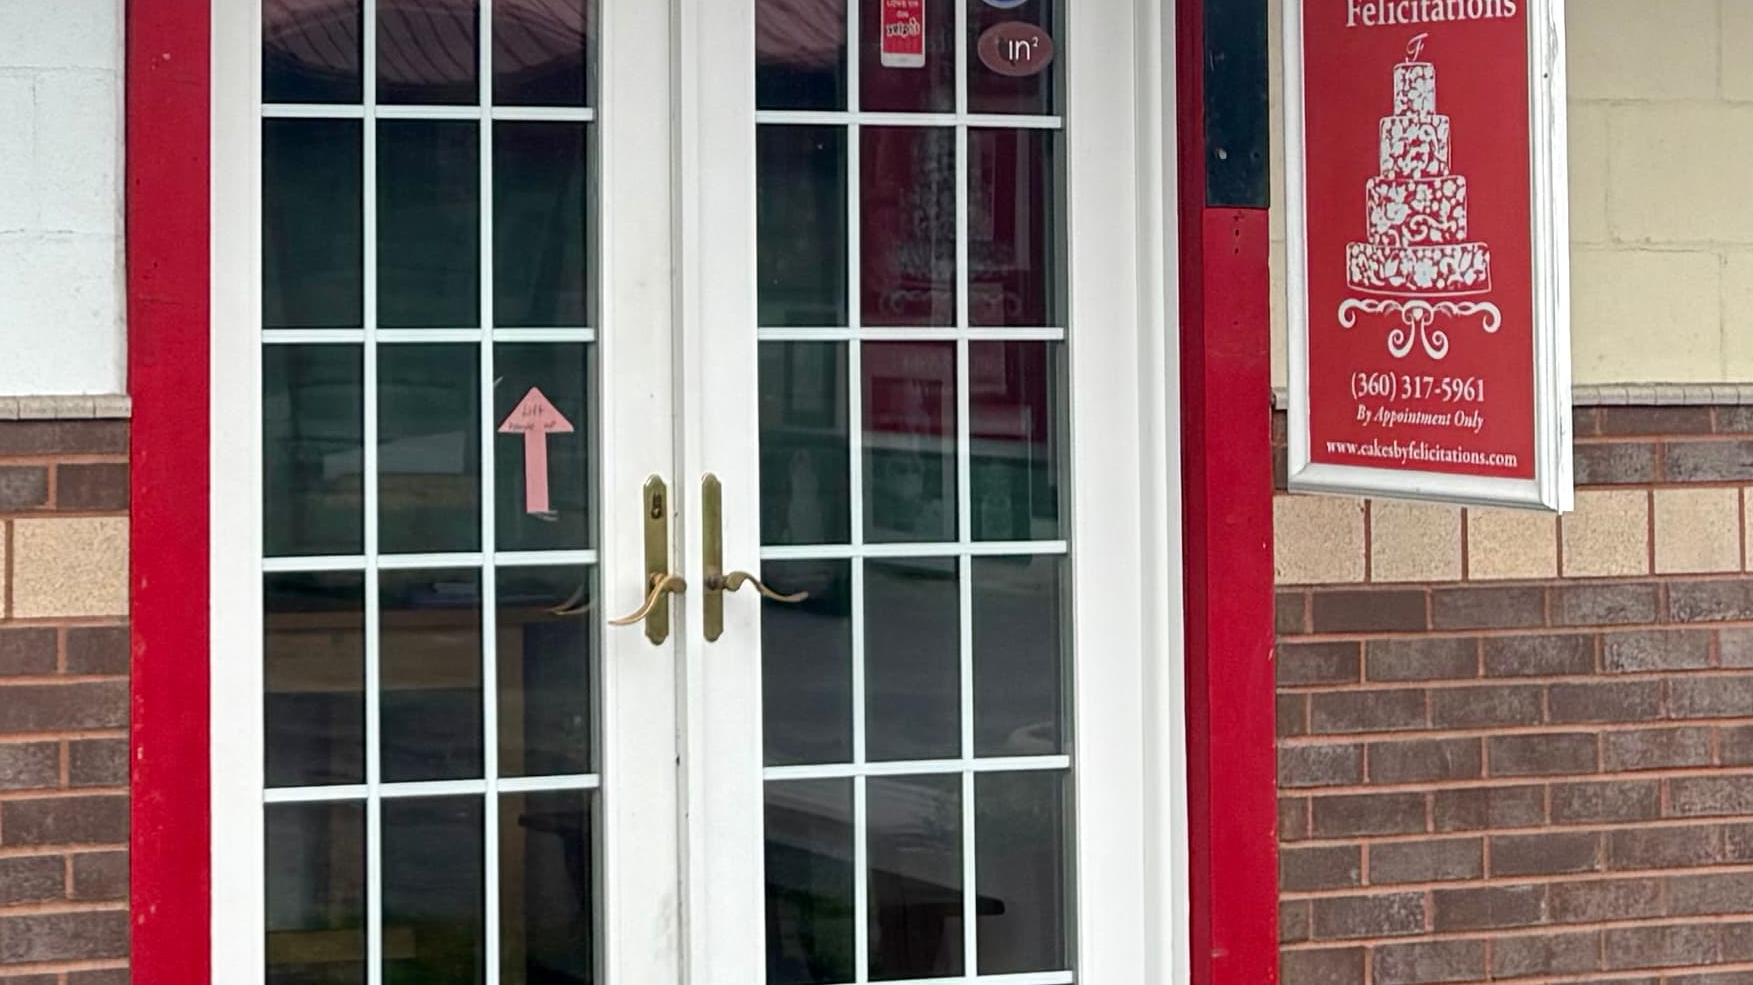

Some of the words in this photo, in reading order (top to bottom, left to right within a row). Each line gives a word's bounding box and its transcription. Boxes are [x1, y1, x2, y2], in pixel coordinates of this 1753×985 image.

[1351, 371, 1397, 402] (360)
[1401, 375, 1485, 403] 317-5961
[1357, 404, 1371, 426] By
[1374, 406, 1451, 427] Appointment
[1454, 410, 1484, 434] Only
[1326, 438, 1518, 467] www.cakesbyfelicitations.com
